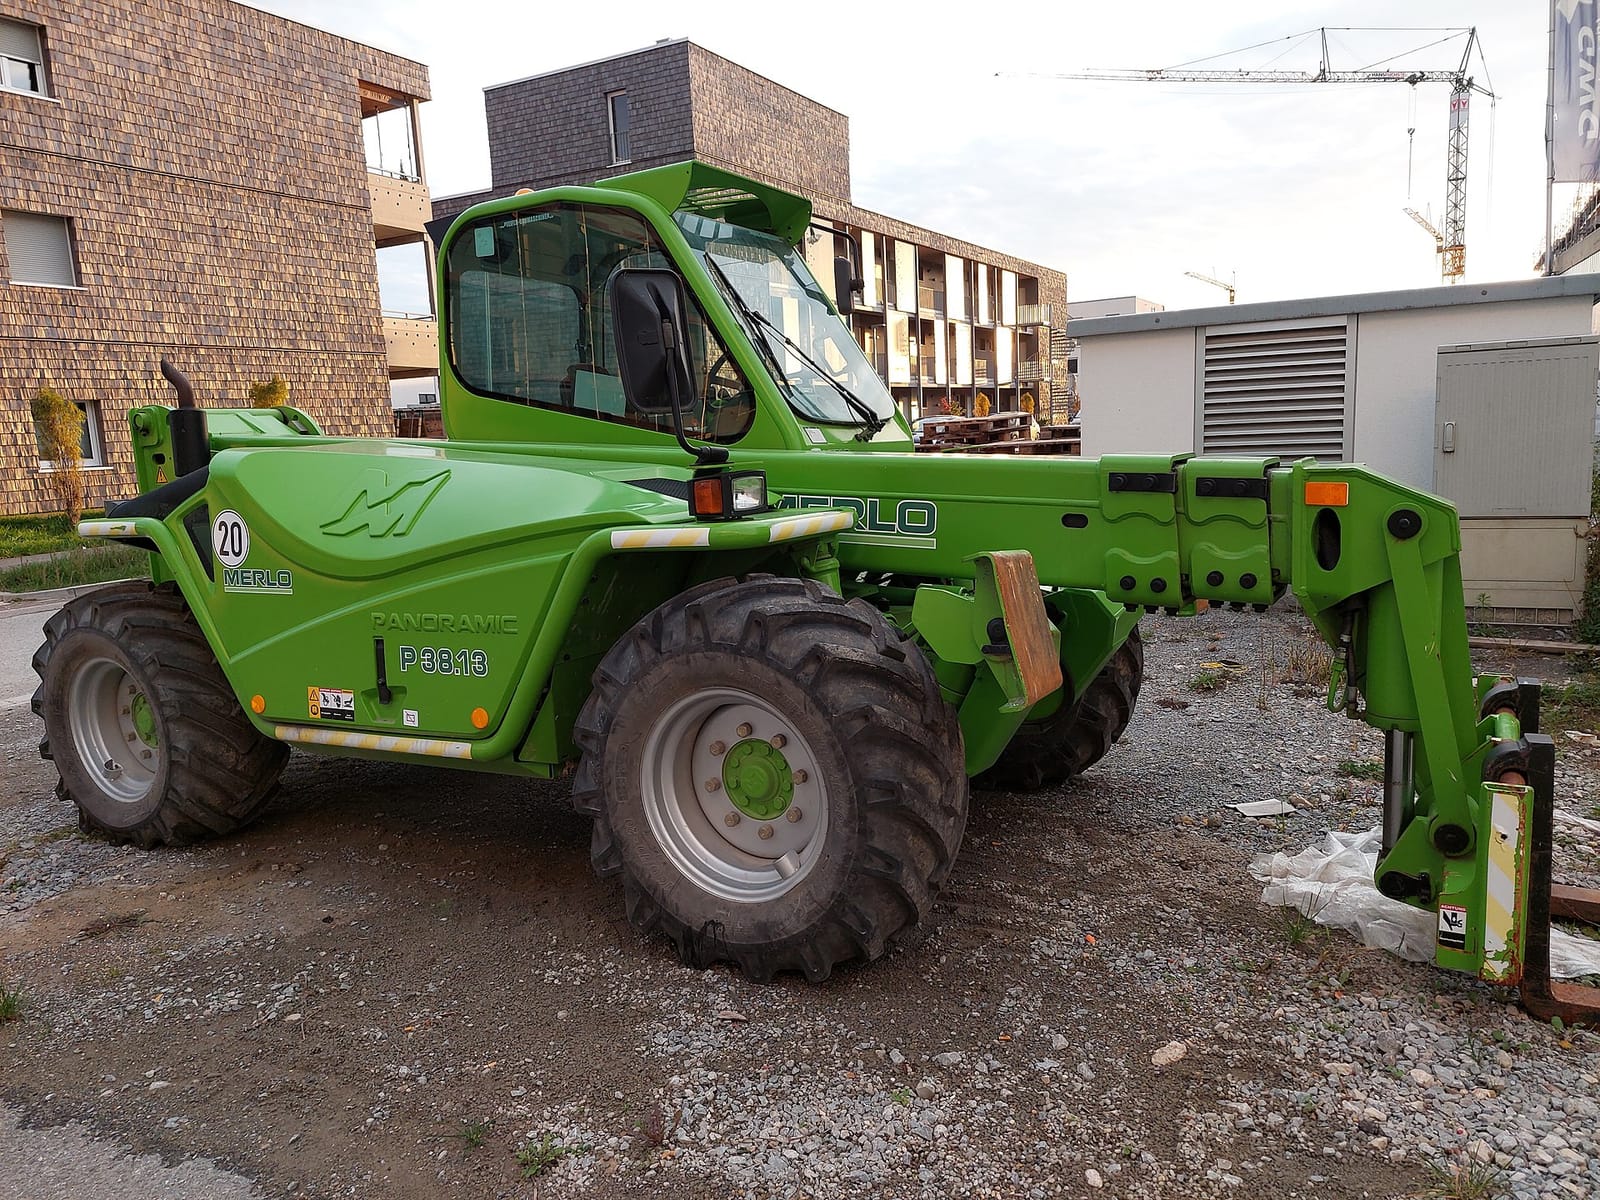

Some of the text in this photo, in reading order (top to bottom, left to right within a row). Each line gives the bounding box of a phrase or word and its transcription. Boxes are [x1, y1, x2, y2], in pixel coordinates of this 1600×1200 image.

[218, 520, 243, 557] 20
[223, 568, 293, 588] MERLO
[371, 612, 519, 635] PANORAMIC
[420, 646, 488, 677] 38.13
